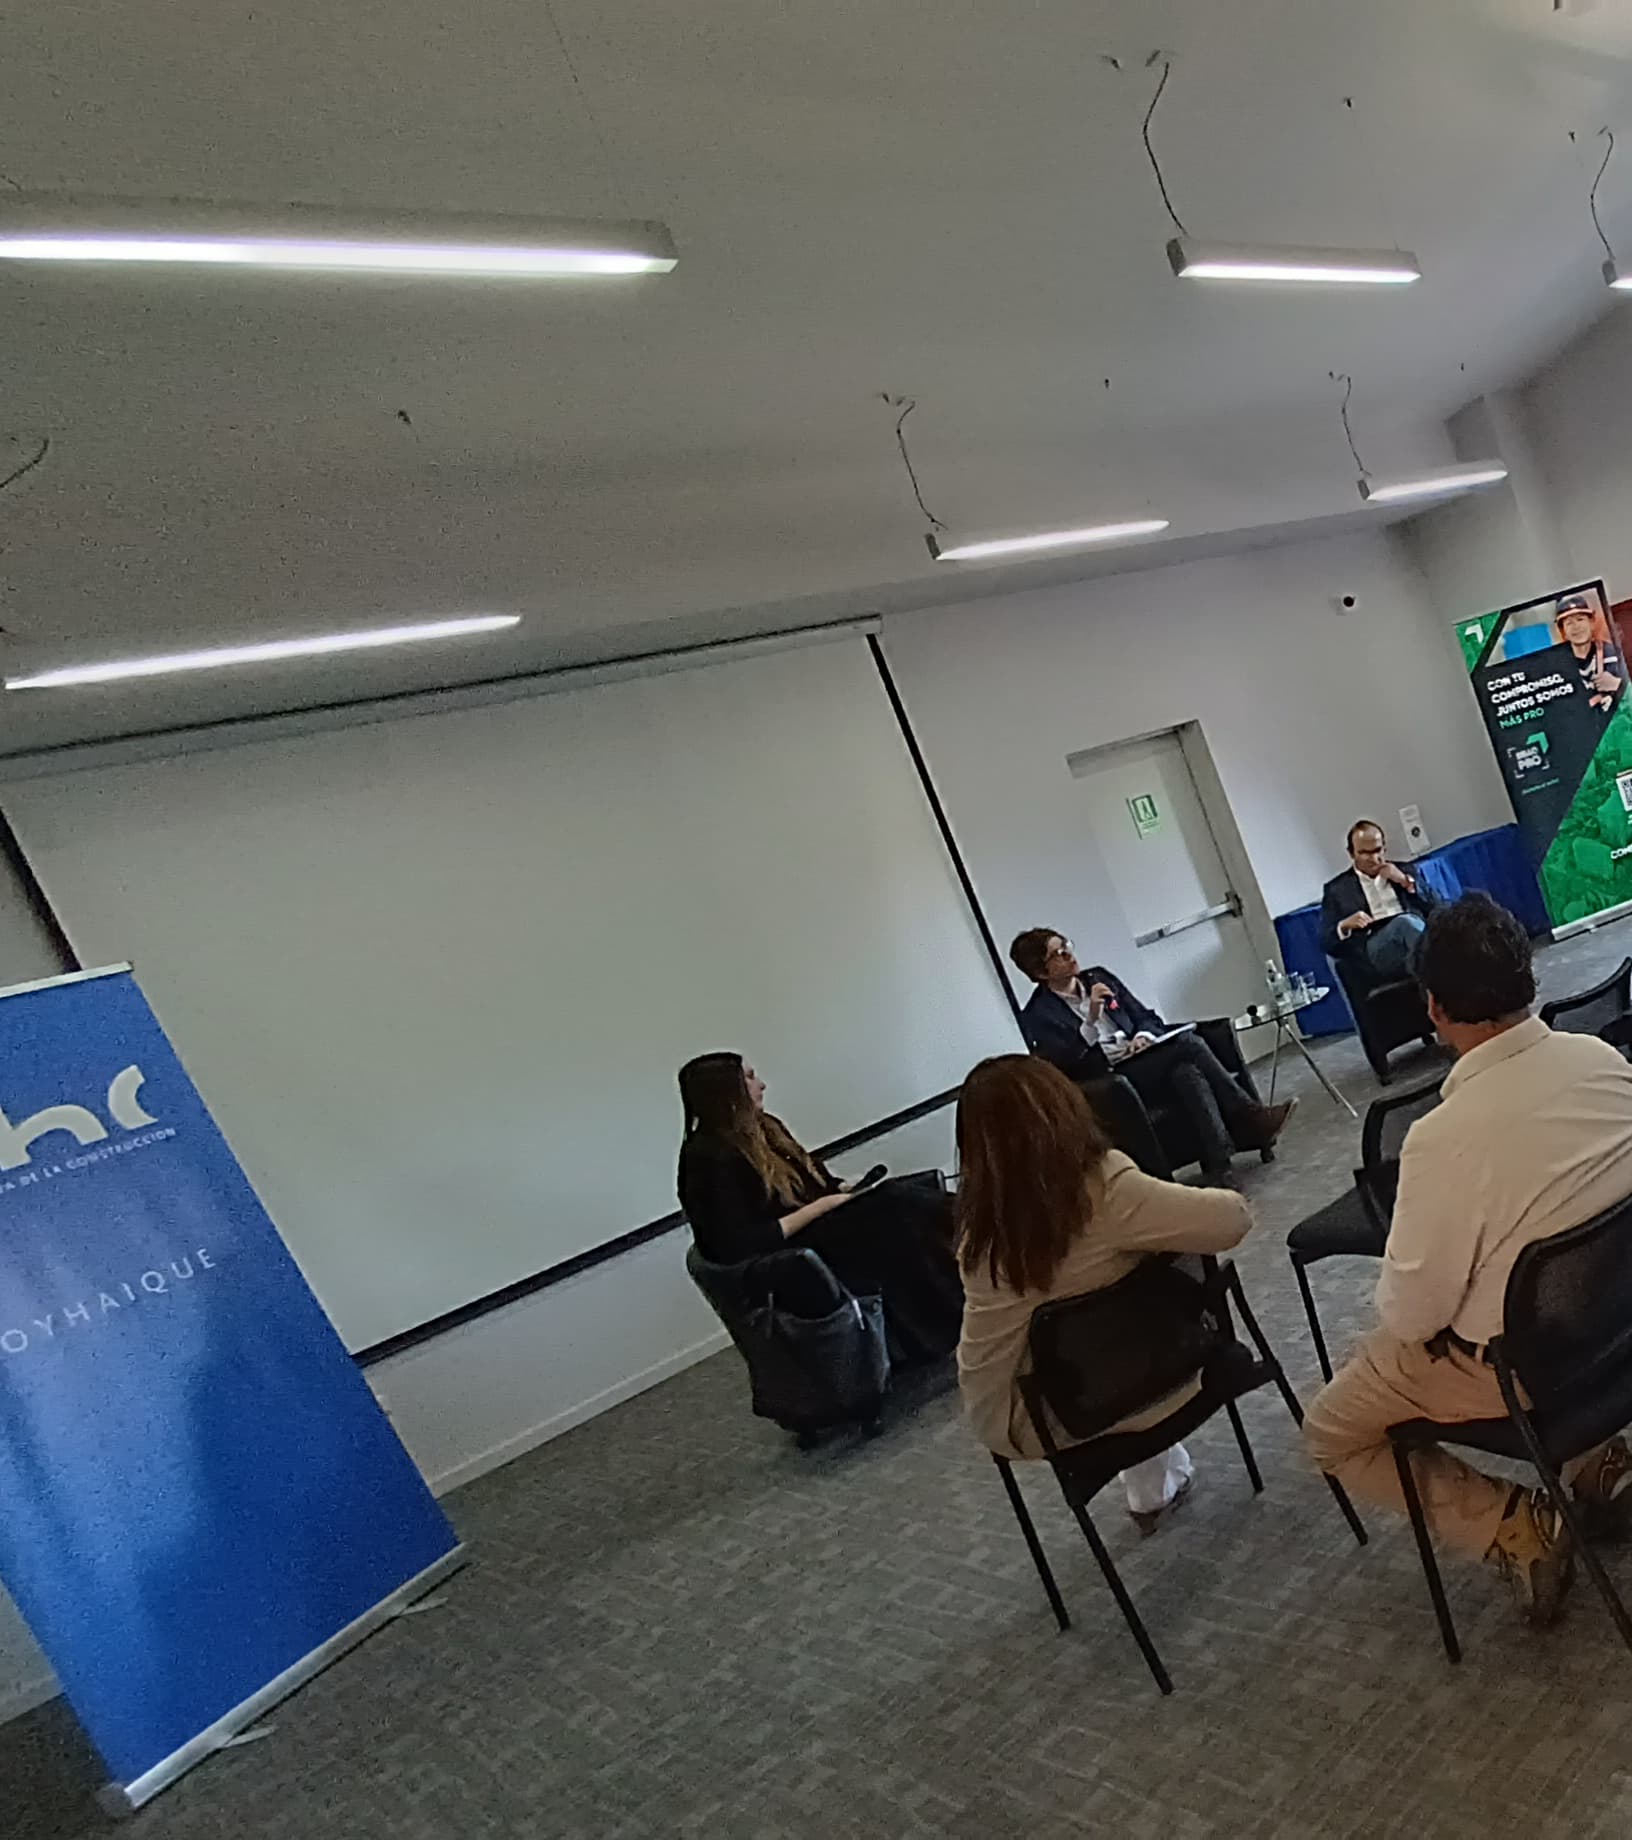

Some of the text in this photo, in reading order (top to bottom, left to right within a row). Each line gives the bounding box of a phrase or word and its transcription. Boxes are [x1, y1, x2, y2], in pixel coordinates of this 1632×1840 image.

[1487, 676, 1511, 691] CON
[1497, 683, 1574, 717] JUNTOS SOMOS
[1523, 707, 1544, 720] PRO
